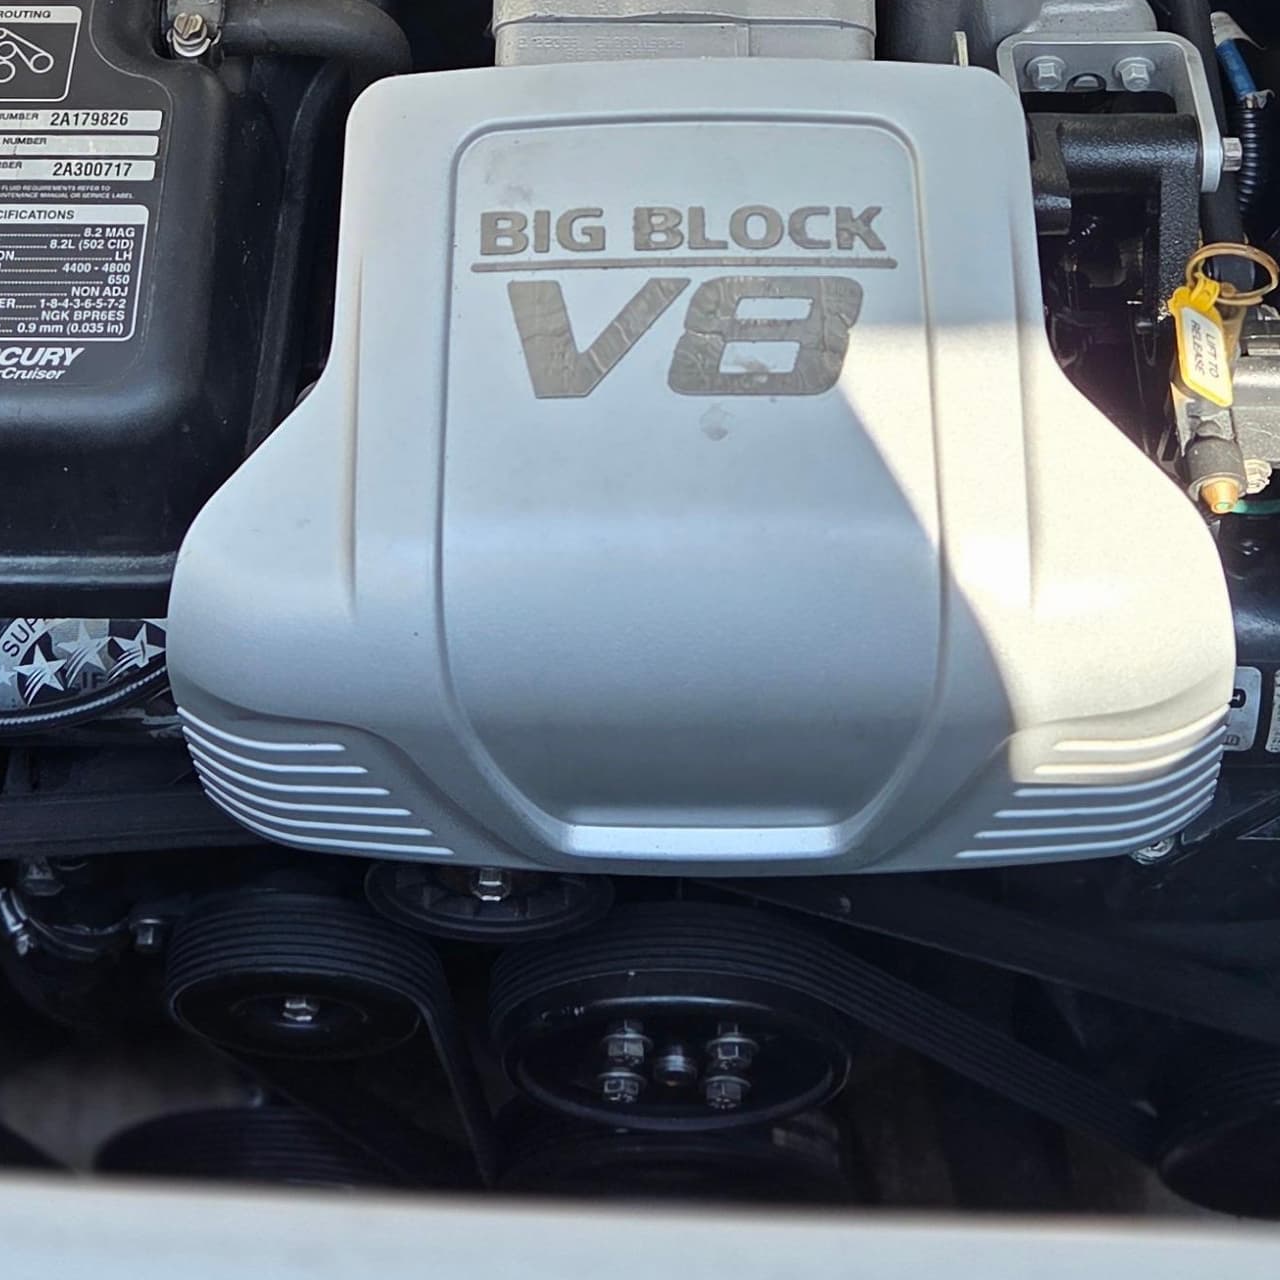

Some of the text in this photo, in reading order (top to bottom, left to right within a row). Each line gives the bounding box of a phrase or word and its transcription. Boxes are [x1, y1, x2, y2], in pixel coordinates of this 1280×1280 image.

[50, 112, 129, 127] 2A179826
[2, 137, 47, 145] NUMBER
[52, 162, 132, 177] 2A300717
[83, 228, 102, 238] 8.2
[105, 228, 135, 238] MAG
[480, 204, 887, 255] BIG BLOCK
[49, 239, 76, 249] 8.2L
[78, 239, 104, 251] (502
[107, 239, 134, 251] CID)
[115, 251, 132, 261] LH
[62, 263, 91, 272] 4400
[102, 262, 131, 272] 4800
[108, 274, 130, 284] 650
[71, 287, 100, 296] NON
[102, 287, 128, 297] ADJ
[39, 298, 126, 308] 1-8-4-3-6-5-7-2
[41, 310, 70, 320] NGK
[72, 310, 125, 320] BPR6ES
[17, 323, 36, 333] 0.9
[39, 325, 63, 333] mm
[66, 322, 105, 335] (0.035
[107, 322, 123, 335] in)
[506, 275, 864, 400] V8
[1191, 319, 1205, 376] RELEASE
[1206, 332, 1219, 378] LIFT TO
[2, 618, 46, 657] SUP
